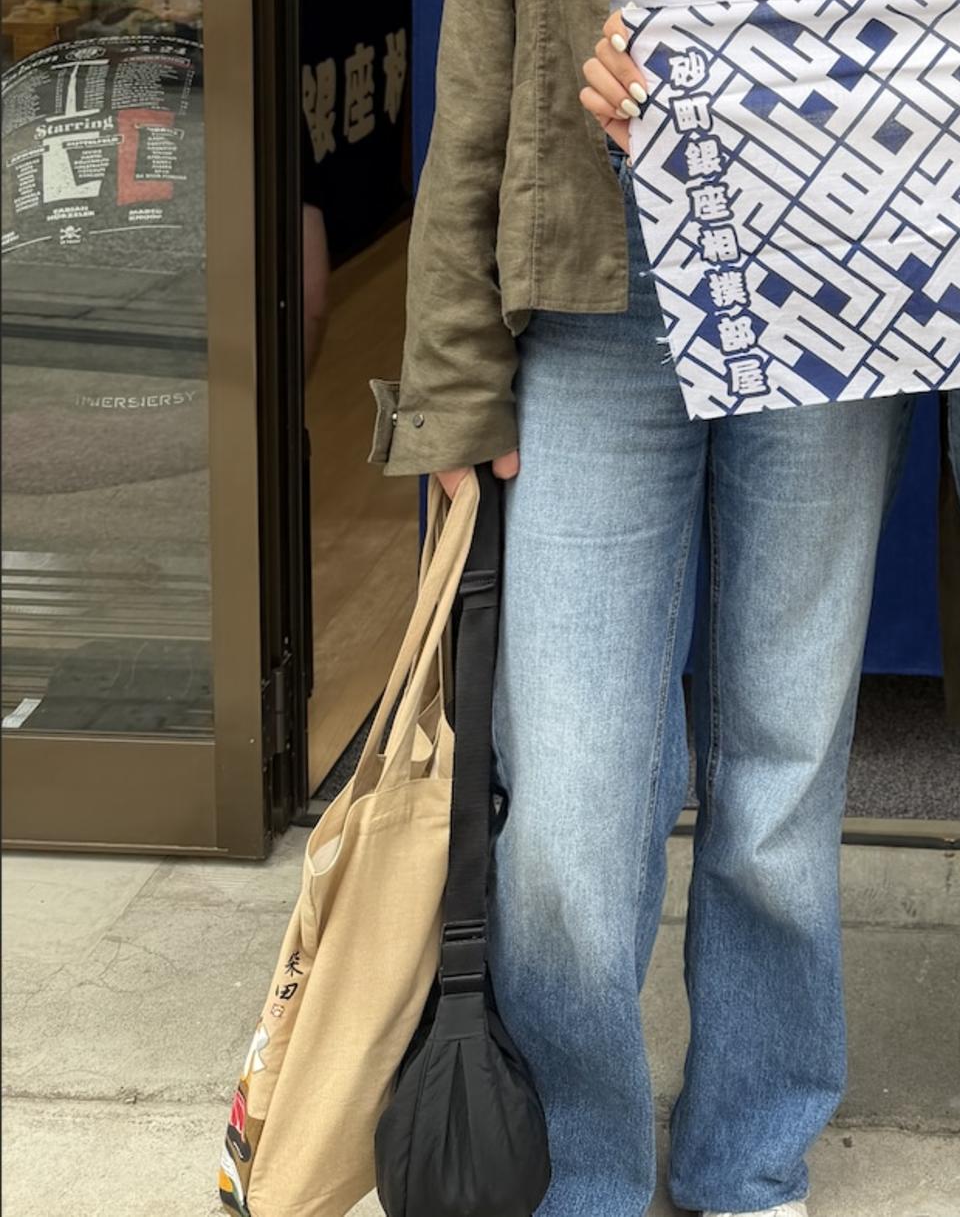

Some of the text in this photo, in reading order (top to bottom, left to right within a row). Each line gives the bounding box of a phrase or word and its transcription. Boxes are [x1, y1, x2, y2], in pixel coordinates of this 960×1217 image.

[34, 115, 115, 141] Starring
[670, 46, 769, 396] 砂町銀座相撲部屋
